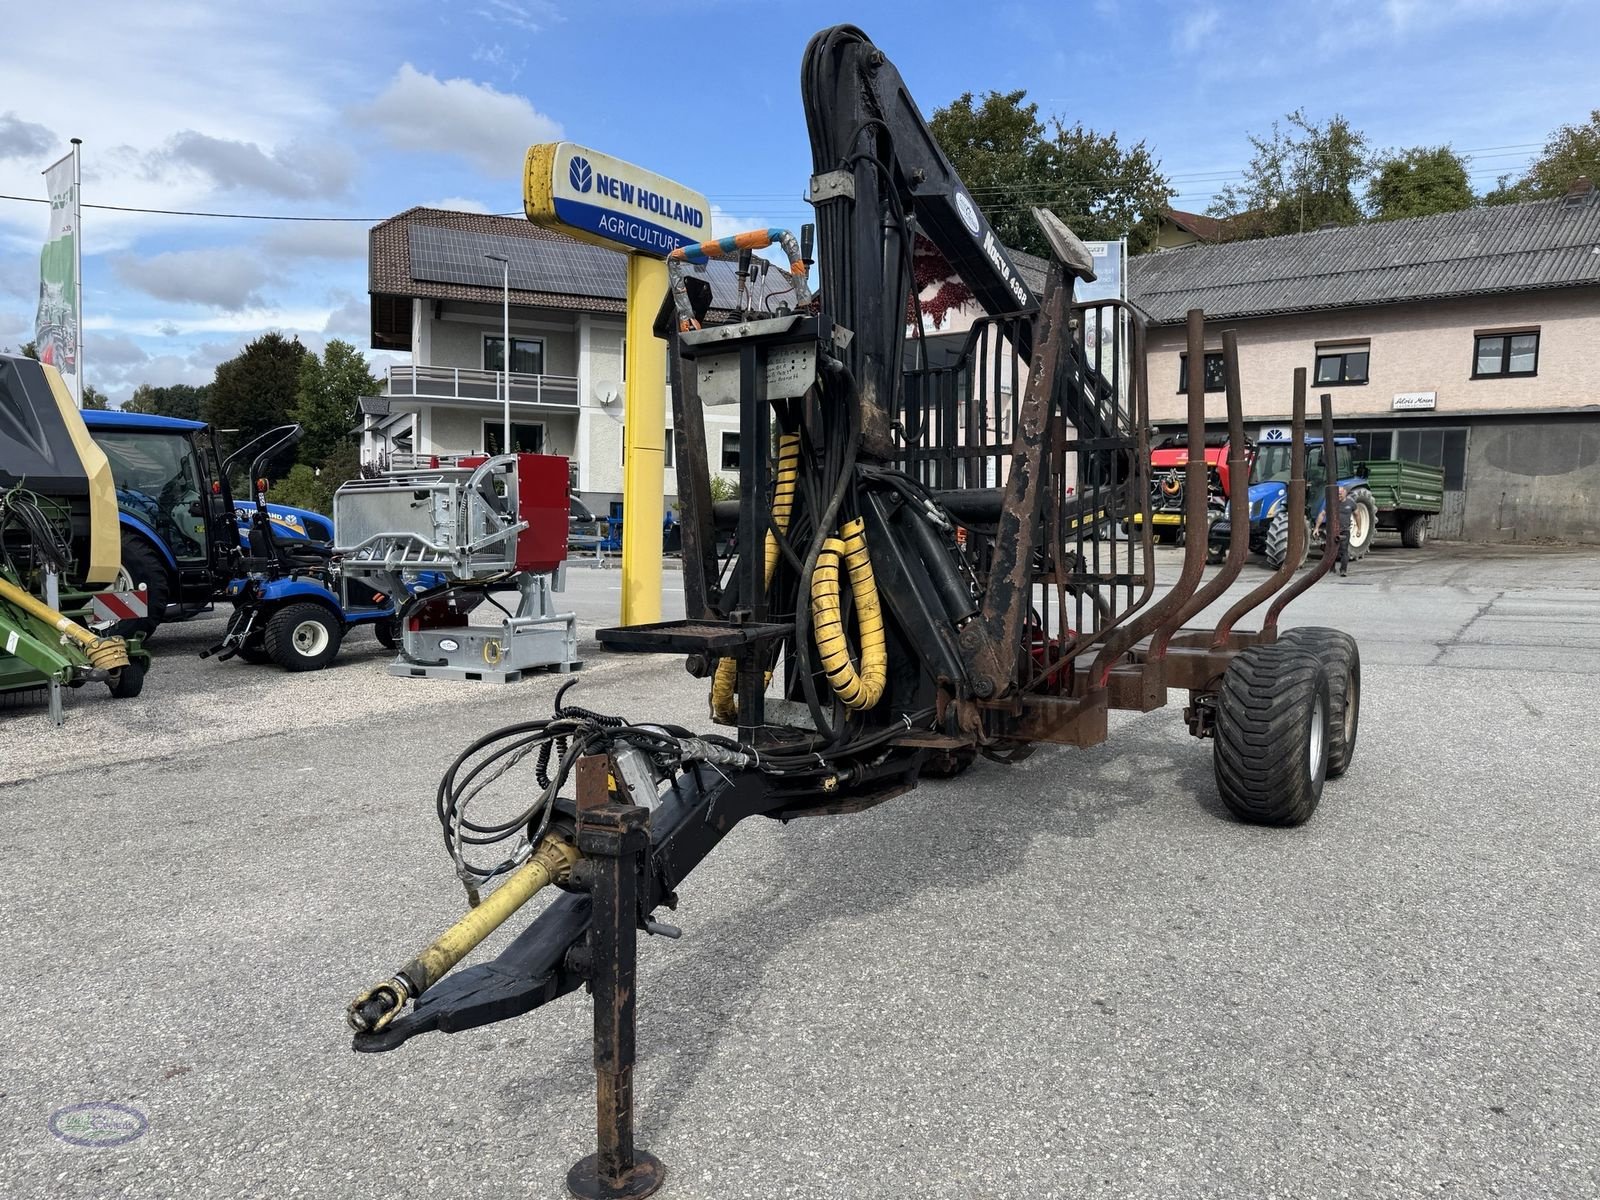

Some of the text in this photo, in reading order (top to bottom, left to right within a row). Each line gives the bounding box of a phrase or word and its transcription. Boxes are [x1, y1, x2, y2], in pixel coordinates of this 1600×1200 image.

[597, 173, 703, 228] NEW HOLLAND
[598, 214, 680, 250] AGRICULTURE
[1009, 277, 1027, 306] 4368
